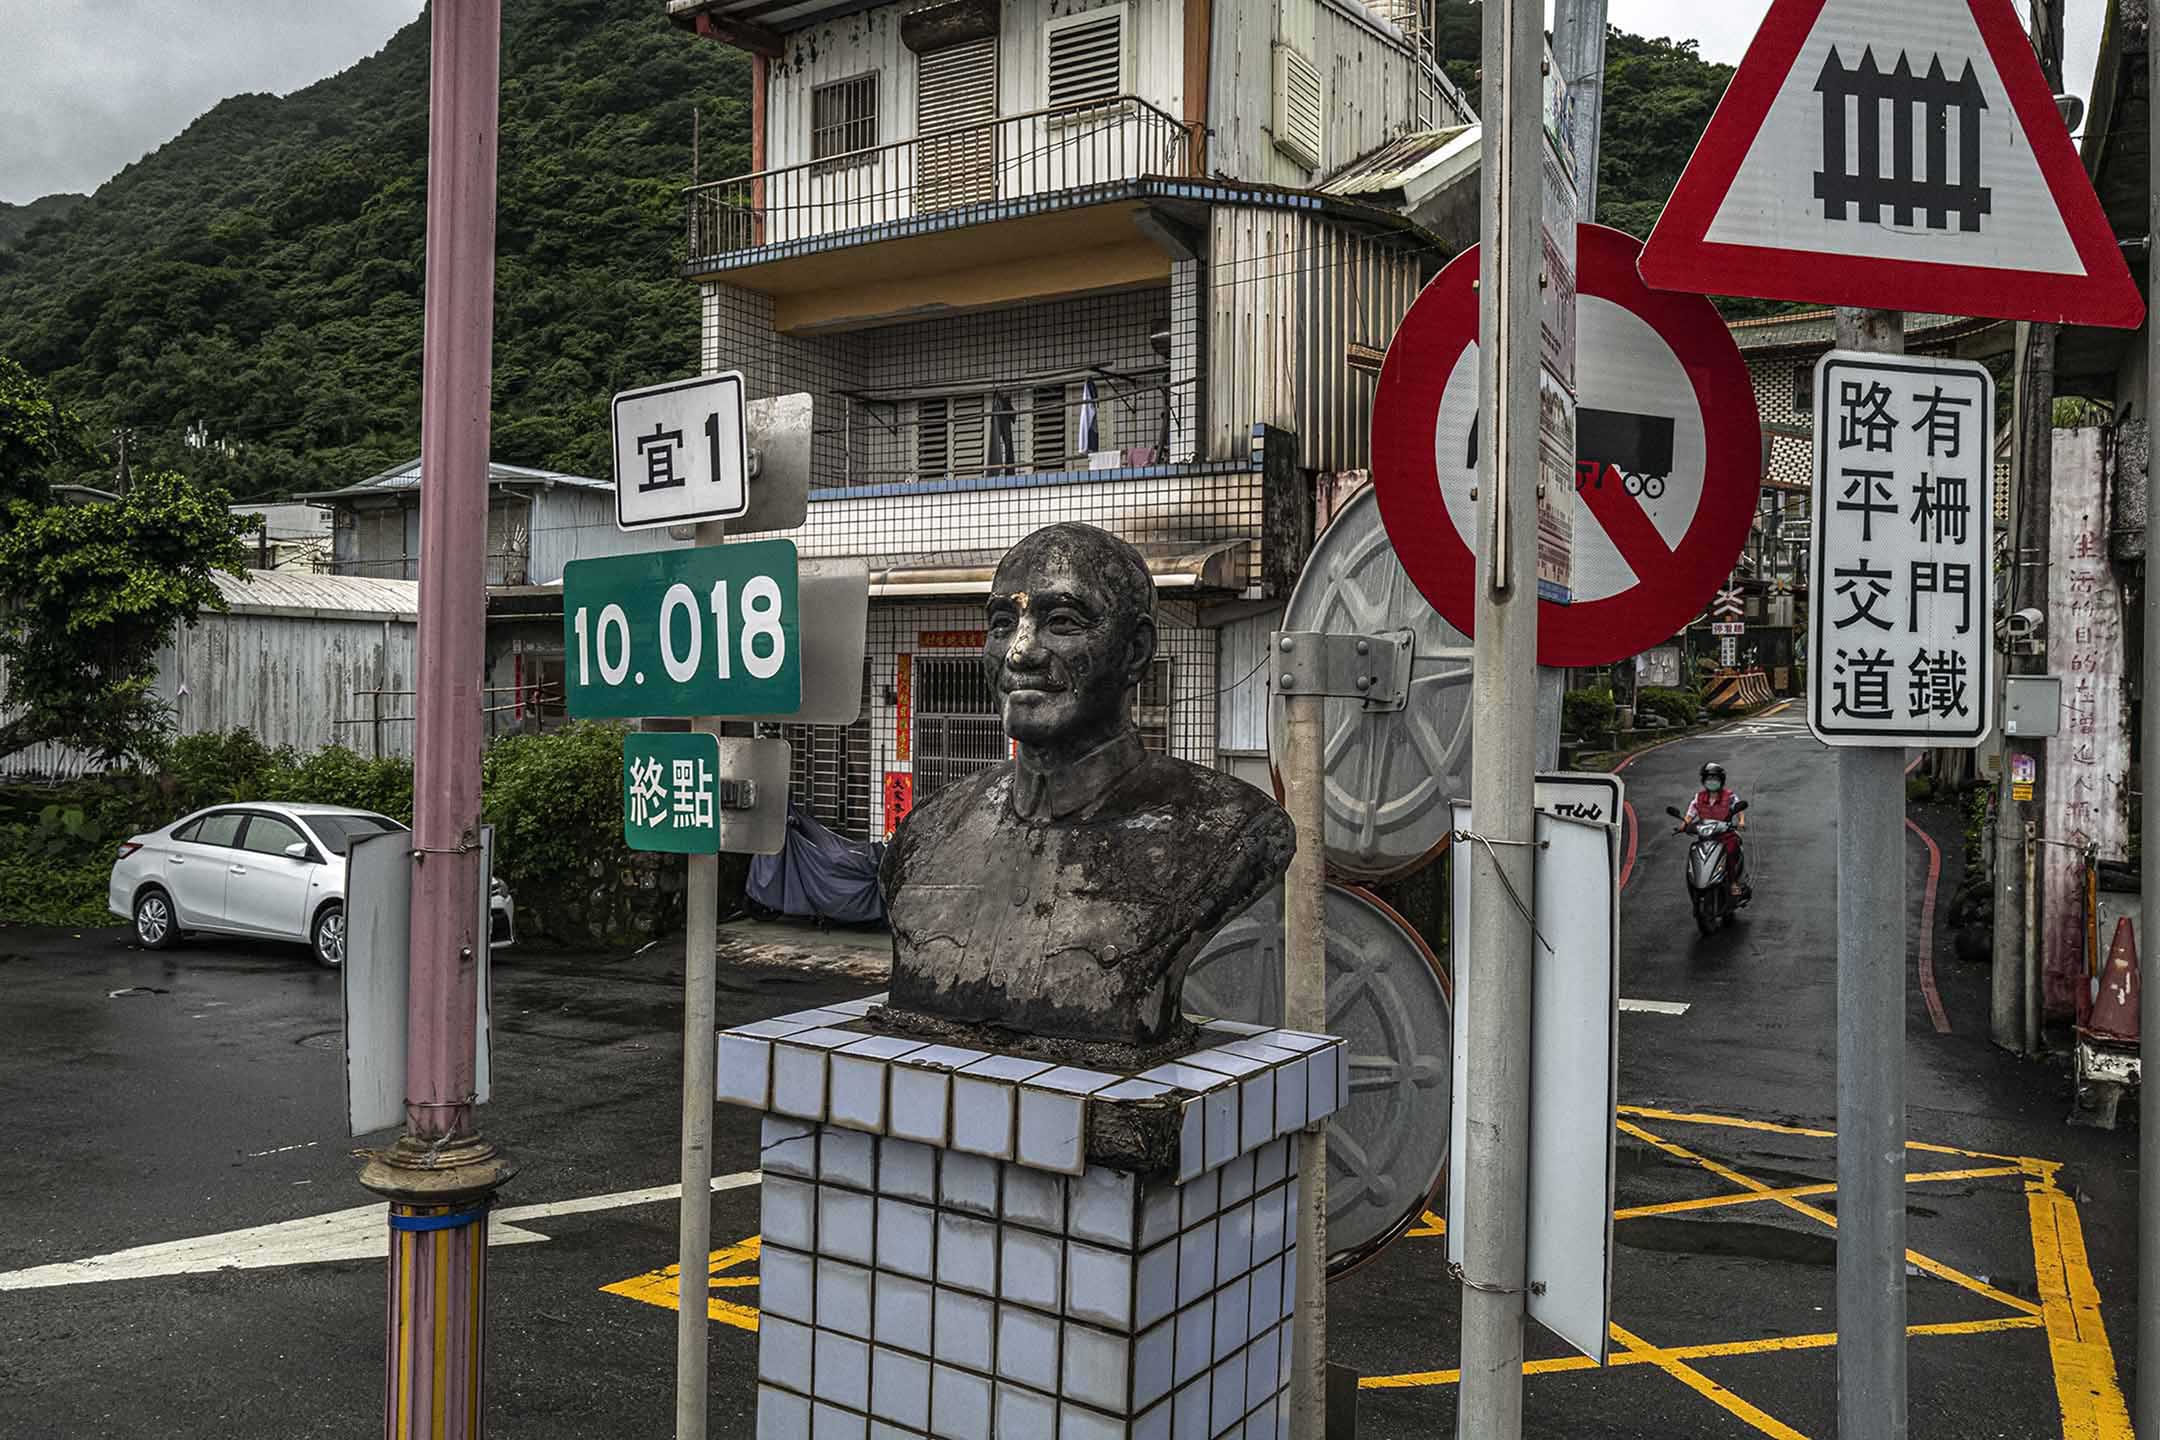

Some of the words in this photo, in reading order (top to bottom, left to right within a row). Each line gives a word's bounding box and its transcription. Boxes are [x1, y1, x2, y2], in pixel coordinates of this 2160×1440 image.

[637, 413, 721, 493] 宜1
[1832, 381, 1899, 720] 路平交道
[1908, 386, 1972, 720] 有柵門鐵
[574, 575, 785, 686] 10.018
[629, 755, 714, 830] 終點
